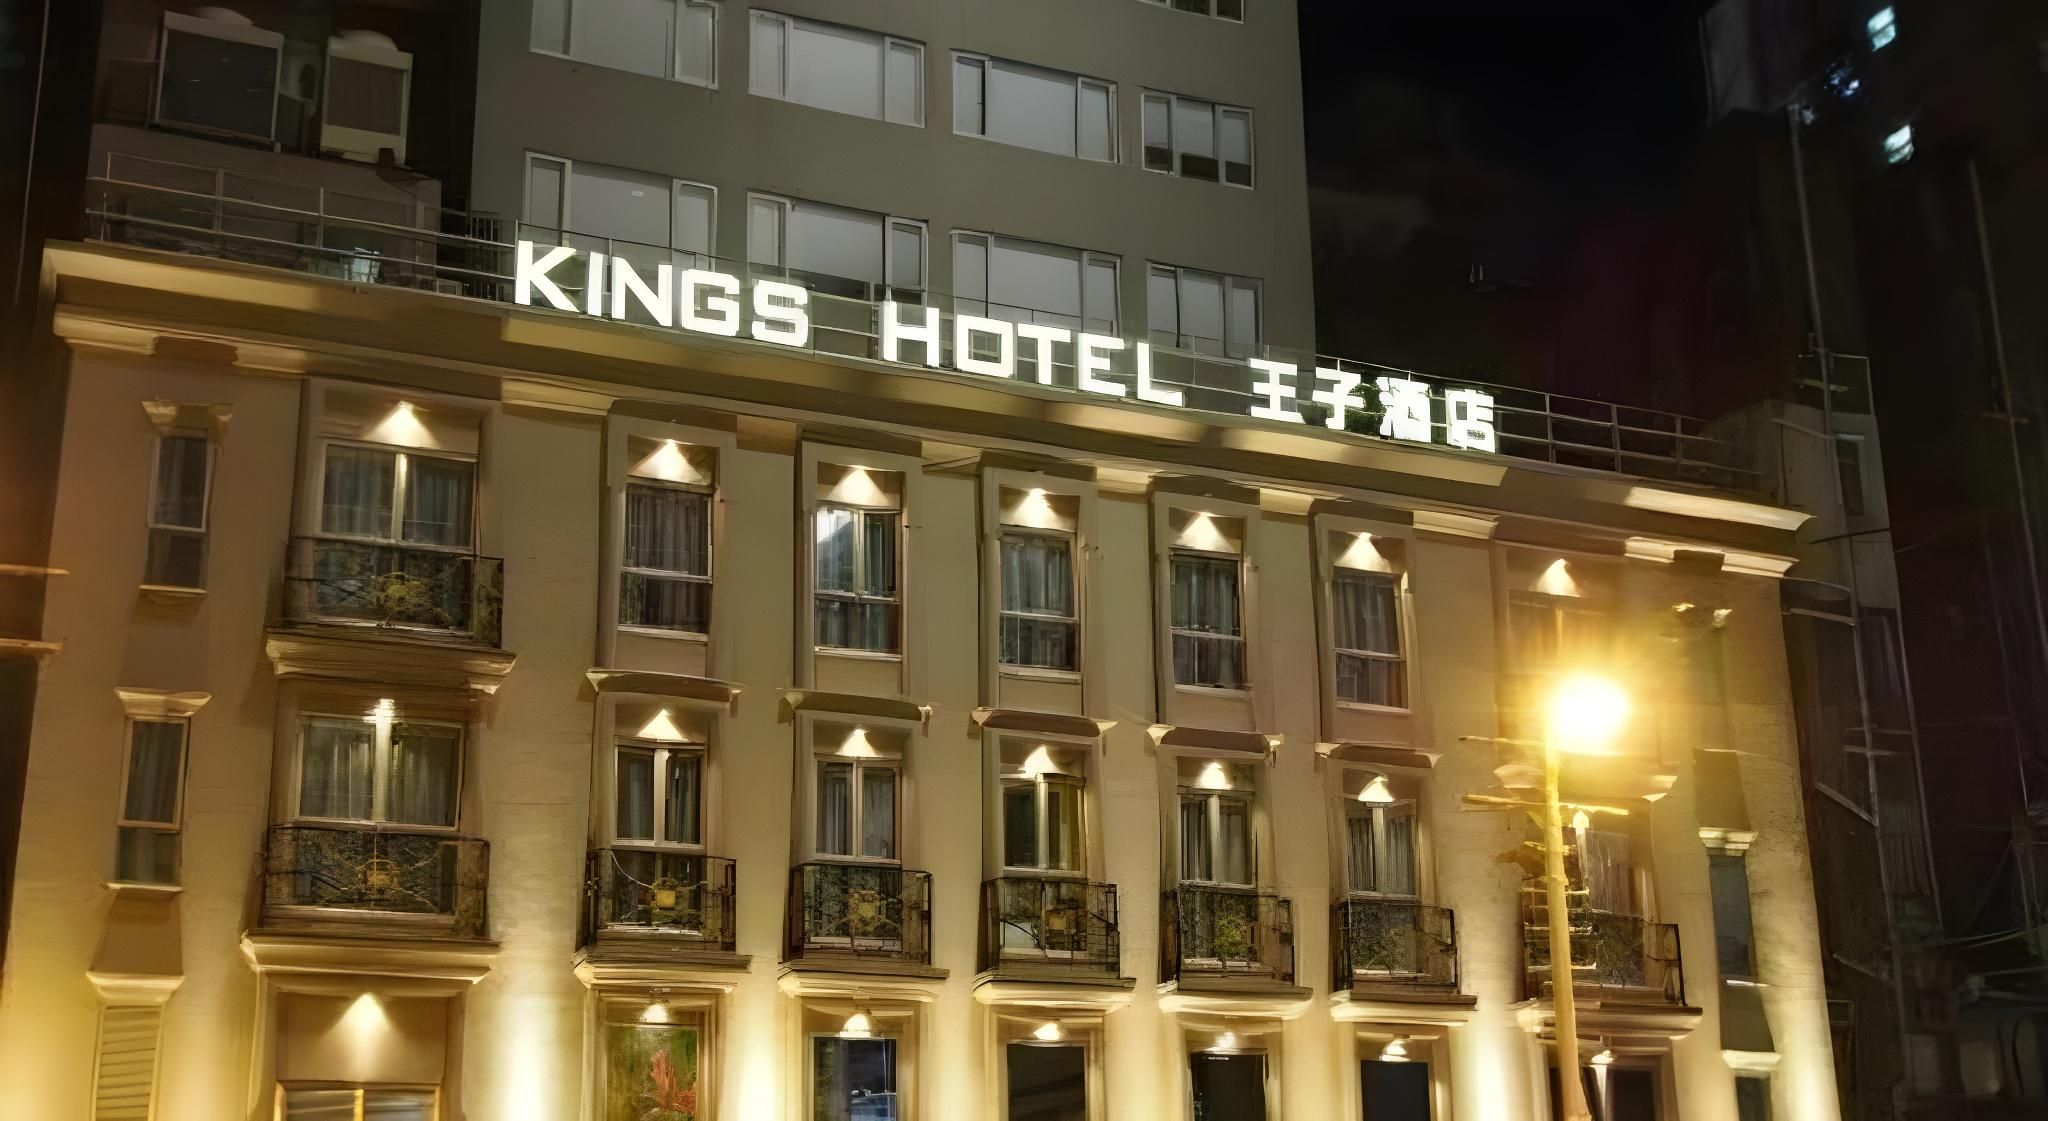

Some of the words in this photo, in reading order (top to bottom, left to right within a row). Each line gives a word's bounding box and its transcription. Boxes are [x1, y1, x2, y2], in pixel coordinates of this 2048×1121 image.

[514, 240, 809, 348] KINGS
[881, 300, 1184, 407] HOTEL
[1248, 357, 1496, 454] 王子酒店
